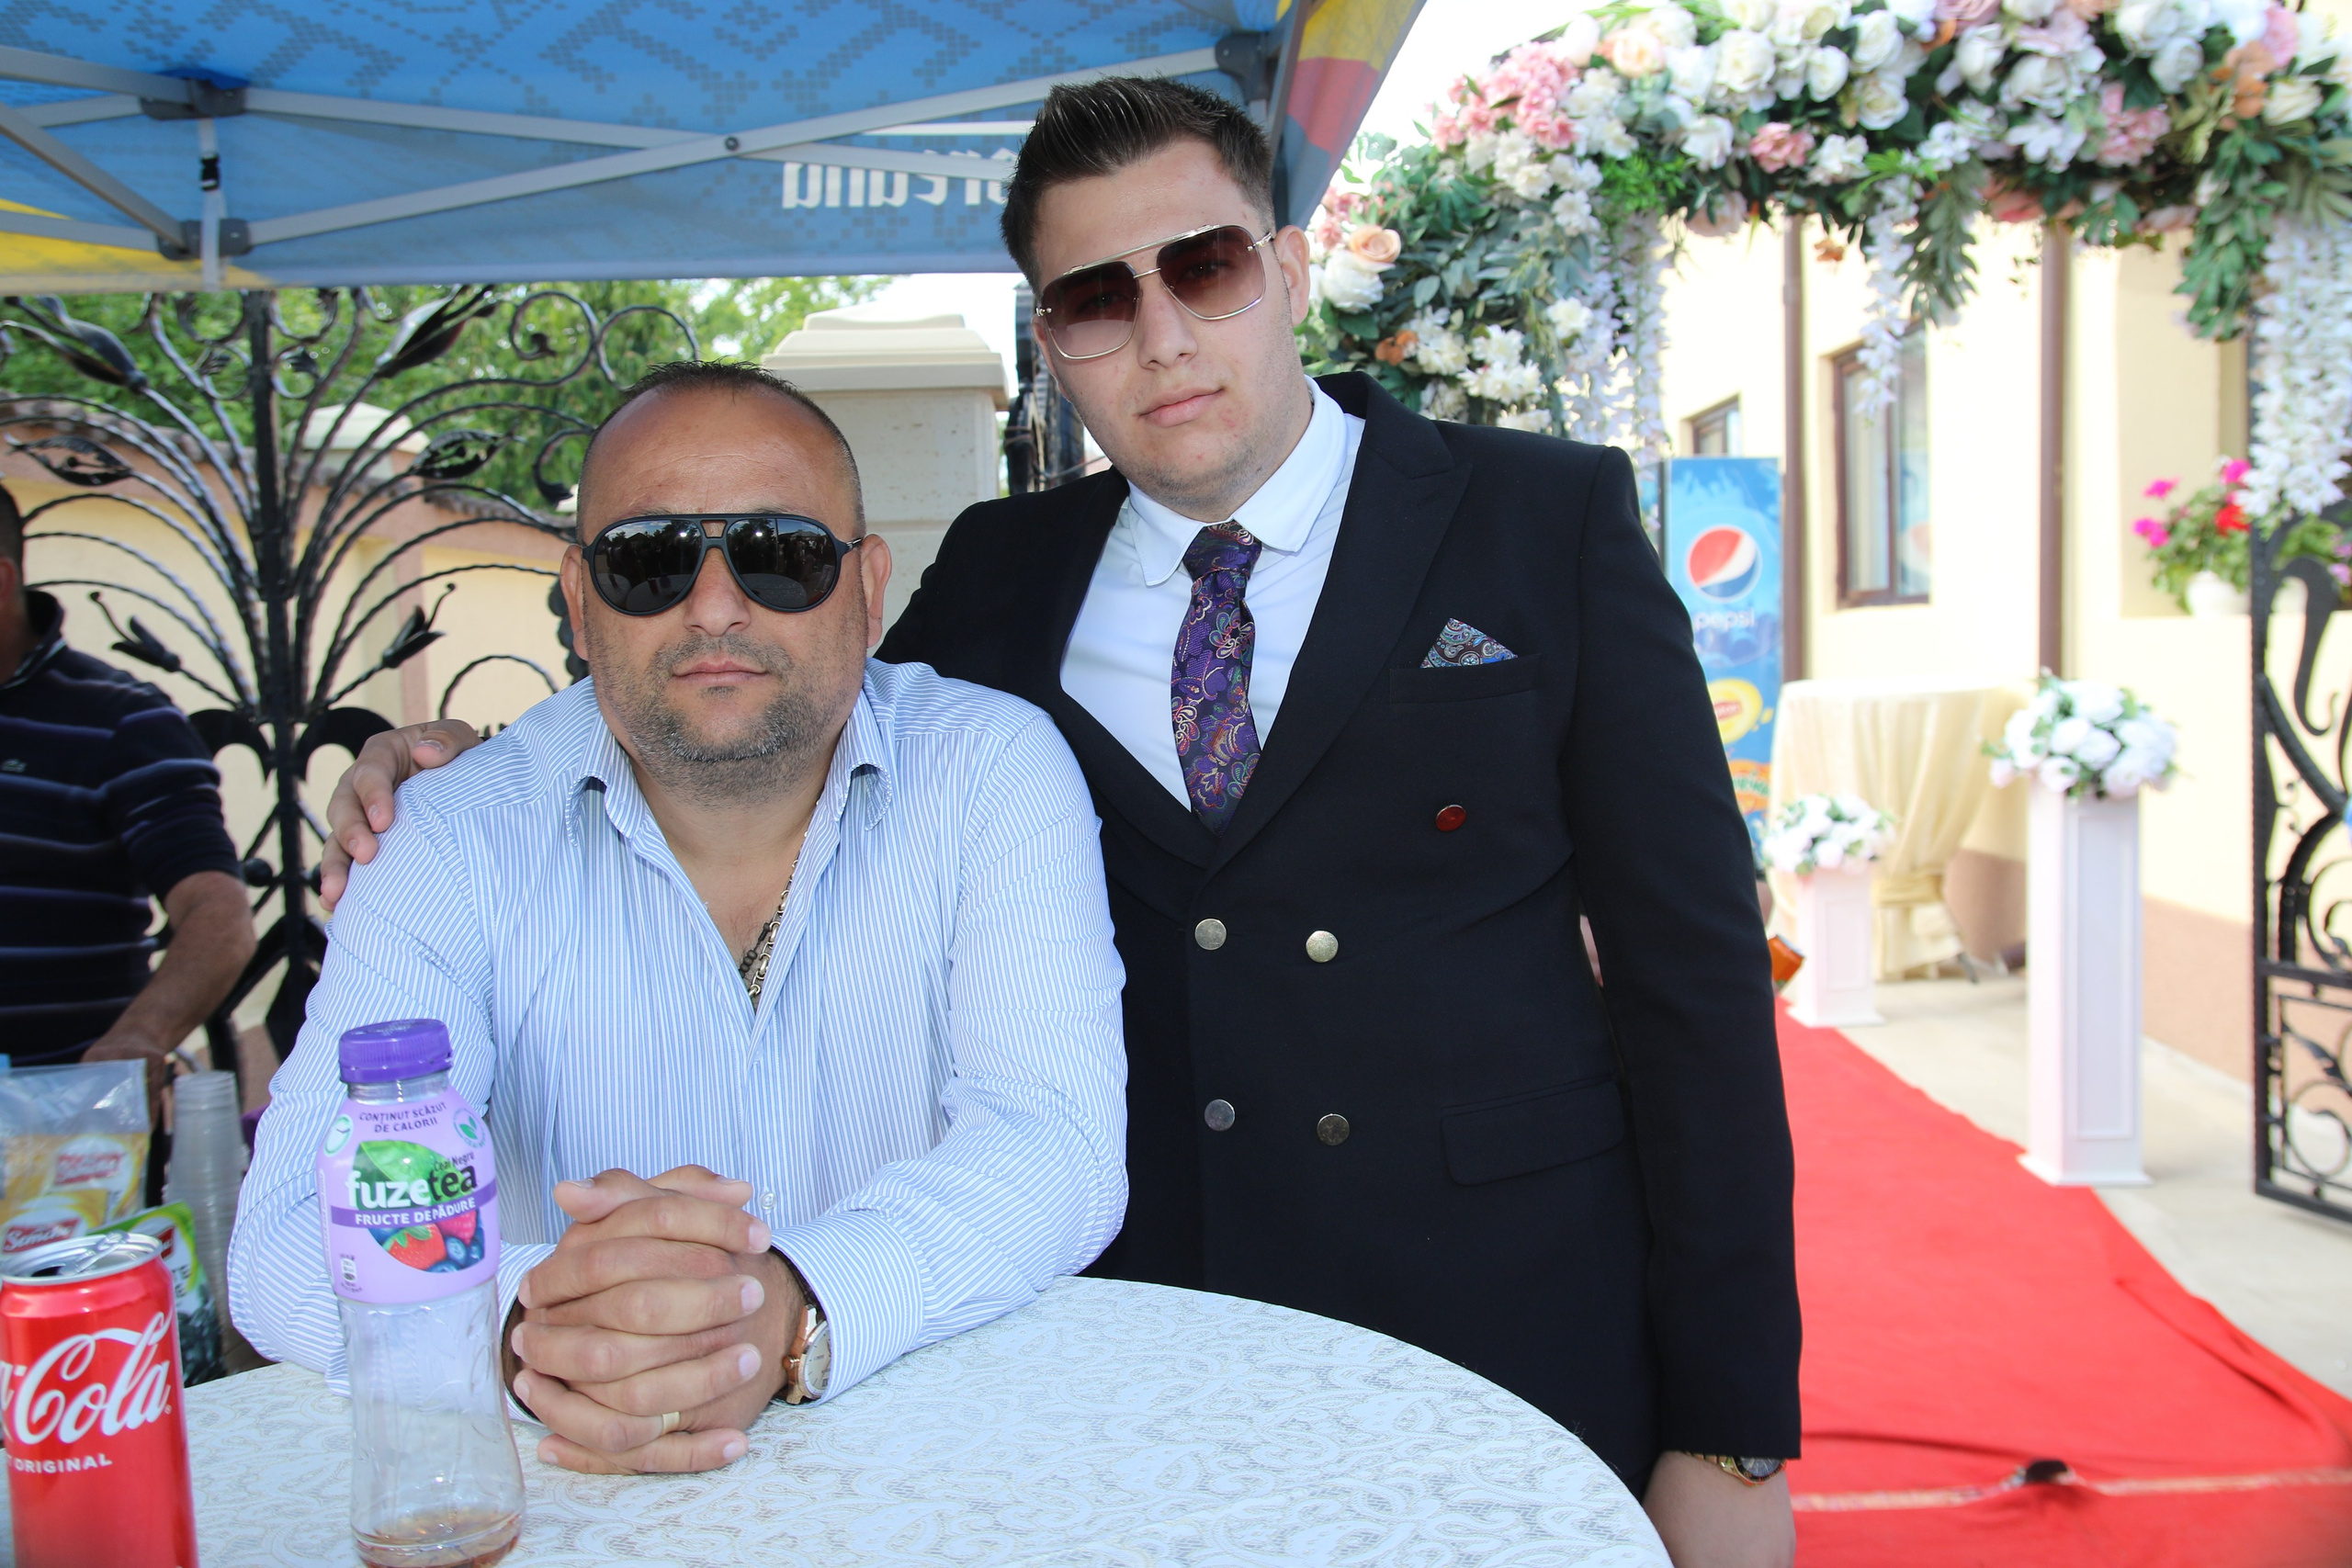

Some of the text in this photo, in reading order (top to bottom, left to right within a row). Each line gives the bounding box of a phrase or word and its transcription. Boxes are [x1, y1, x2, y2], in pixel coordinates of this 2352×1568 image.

[1694, 606, 1756, 632] pepsi
[374, 1117, 438, 1133] DE CALORII
[355, 1213, 411, 1225] FRUCTE
[15, 1452, 113, 1473] ORIGINAL
